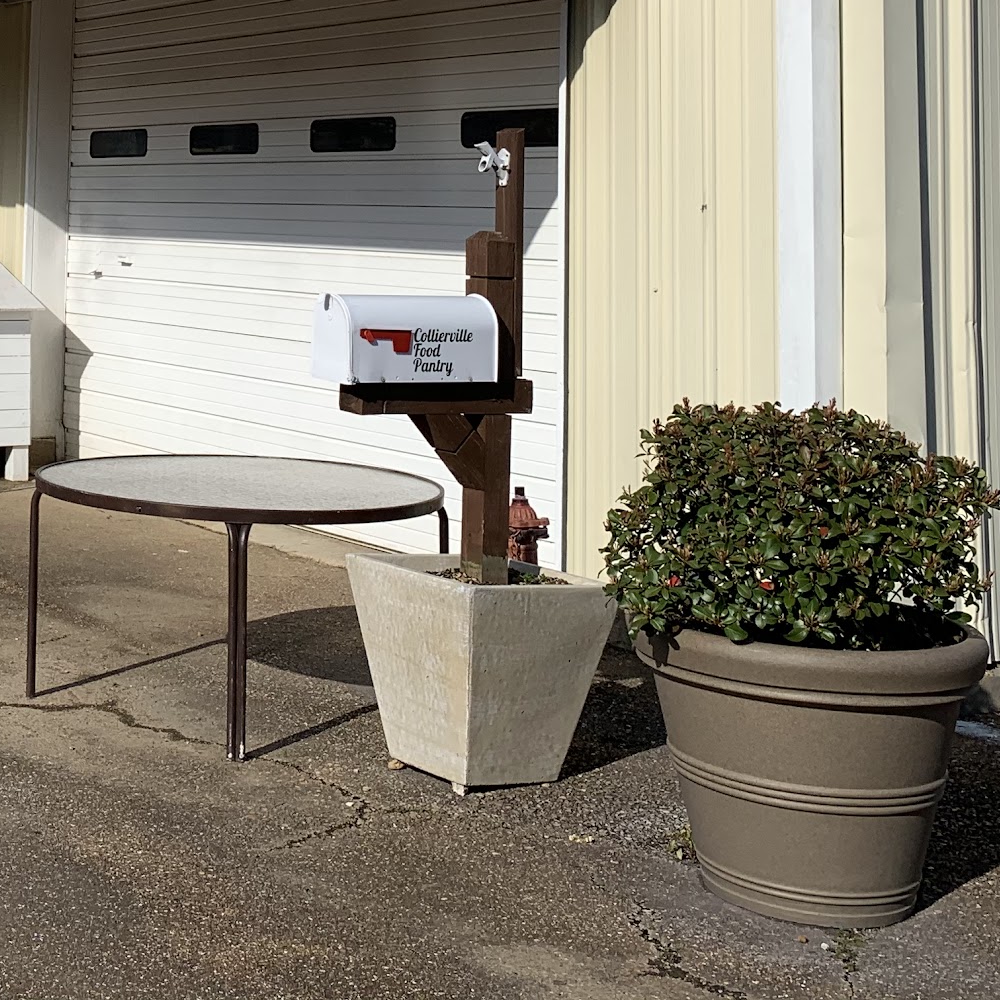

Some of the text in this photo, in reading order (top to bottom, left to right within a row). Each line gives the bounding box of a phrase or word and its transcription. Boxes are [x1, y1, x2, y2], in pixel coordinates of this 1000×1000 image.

[413, 327, 473, 342] Collierville
[413, 343, 441, 357] Food
[413, 358, 454, 376] Pantry
